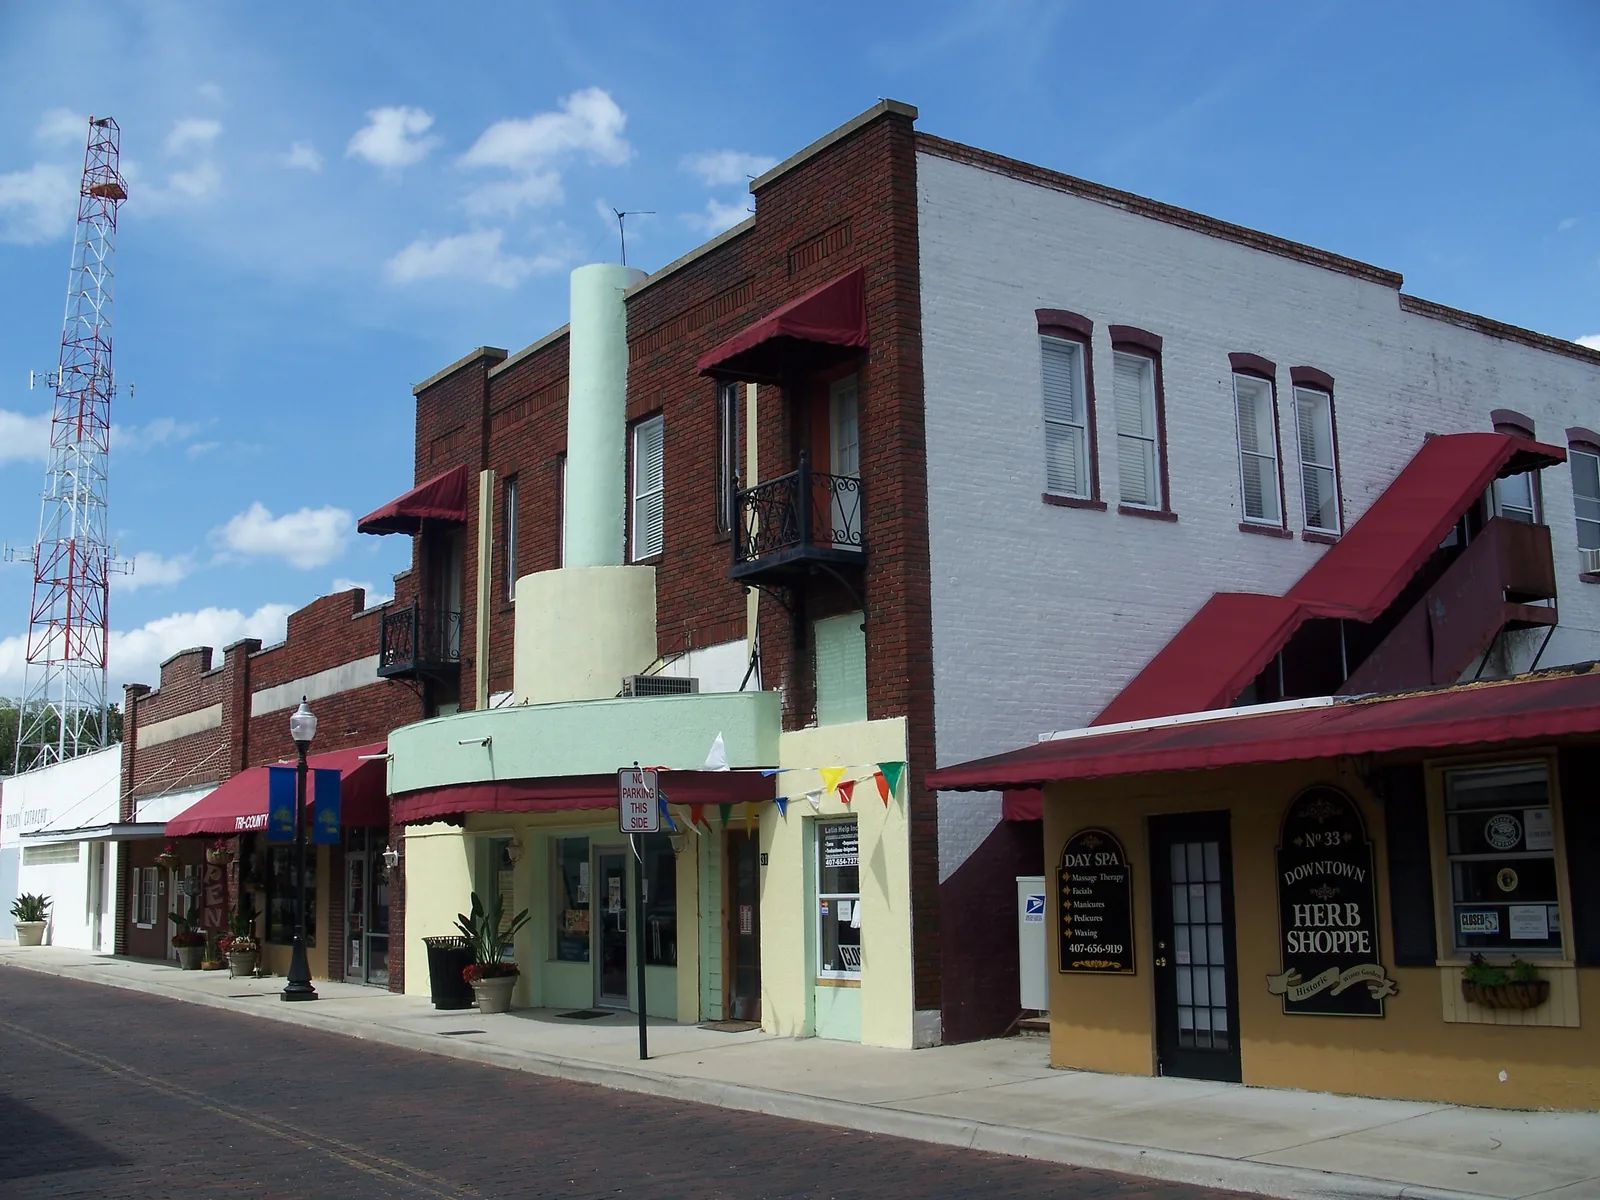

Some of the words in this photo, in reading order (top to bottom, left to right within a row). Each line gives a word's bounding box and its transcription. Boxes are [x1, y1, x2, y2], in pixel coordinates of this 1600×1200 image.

[632, 773, 643, 784] NO
[623, 788, 654, 799] PARKING
[630, 803, 647, 814] THIS
[235, 813, 269, 830] TRI-COUNTY
[631, 817, 648, 828] SIDE
[838, 825, 850, 833] Help
[1324, 831, 1341, 846] 33
[1065, 854, 1091, 867] DAY
[1095, 853, 1119, 866] SPA
[1072, 874, 1097, 883] Massage
[1100, 873, 1124, 882] Therapy
[1284, 861, 1366, 885] DOWNTOWN
[1072, 887, 1092, 895] Facials
[1293, 903, 1361, 927] HERB
[1462, 914, 1484, 925] CLOSED
[1074, 929, 1098, 939] Waxing
[1287, 930, 1371, 954] SHOPPE
[1069, 944, 1123, 953] 407-656-9119
[1296, 975, 1328, 996] Historic
[1343, 971, 1360, 982] Winter
[1361, 968, 1381, 978] Garden
